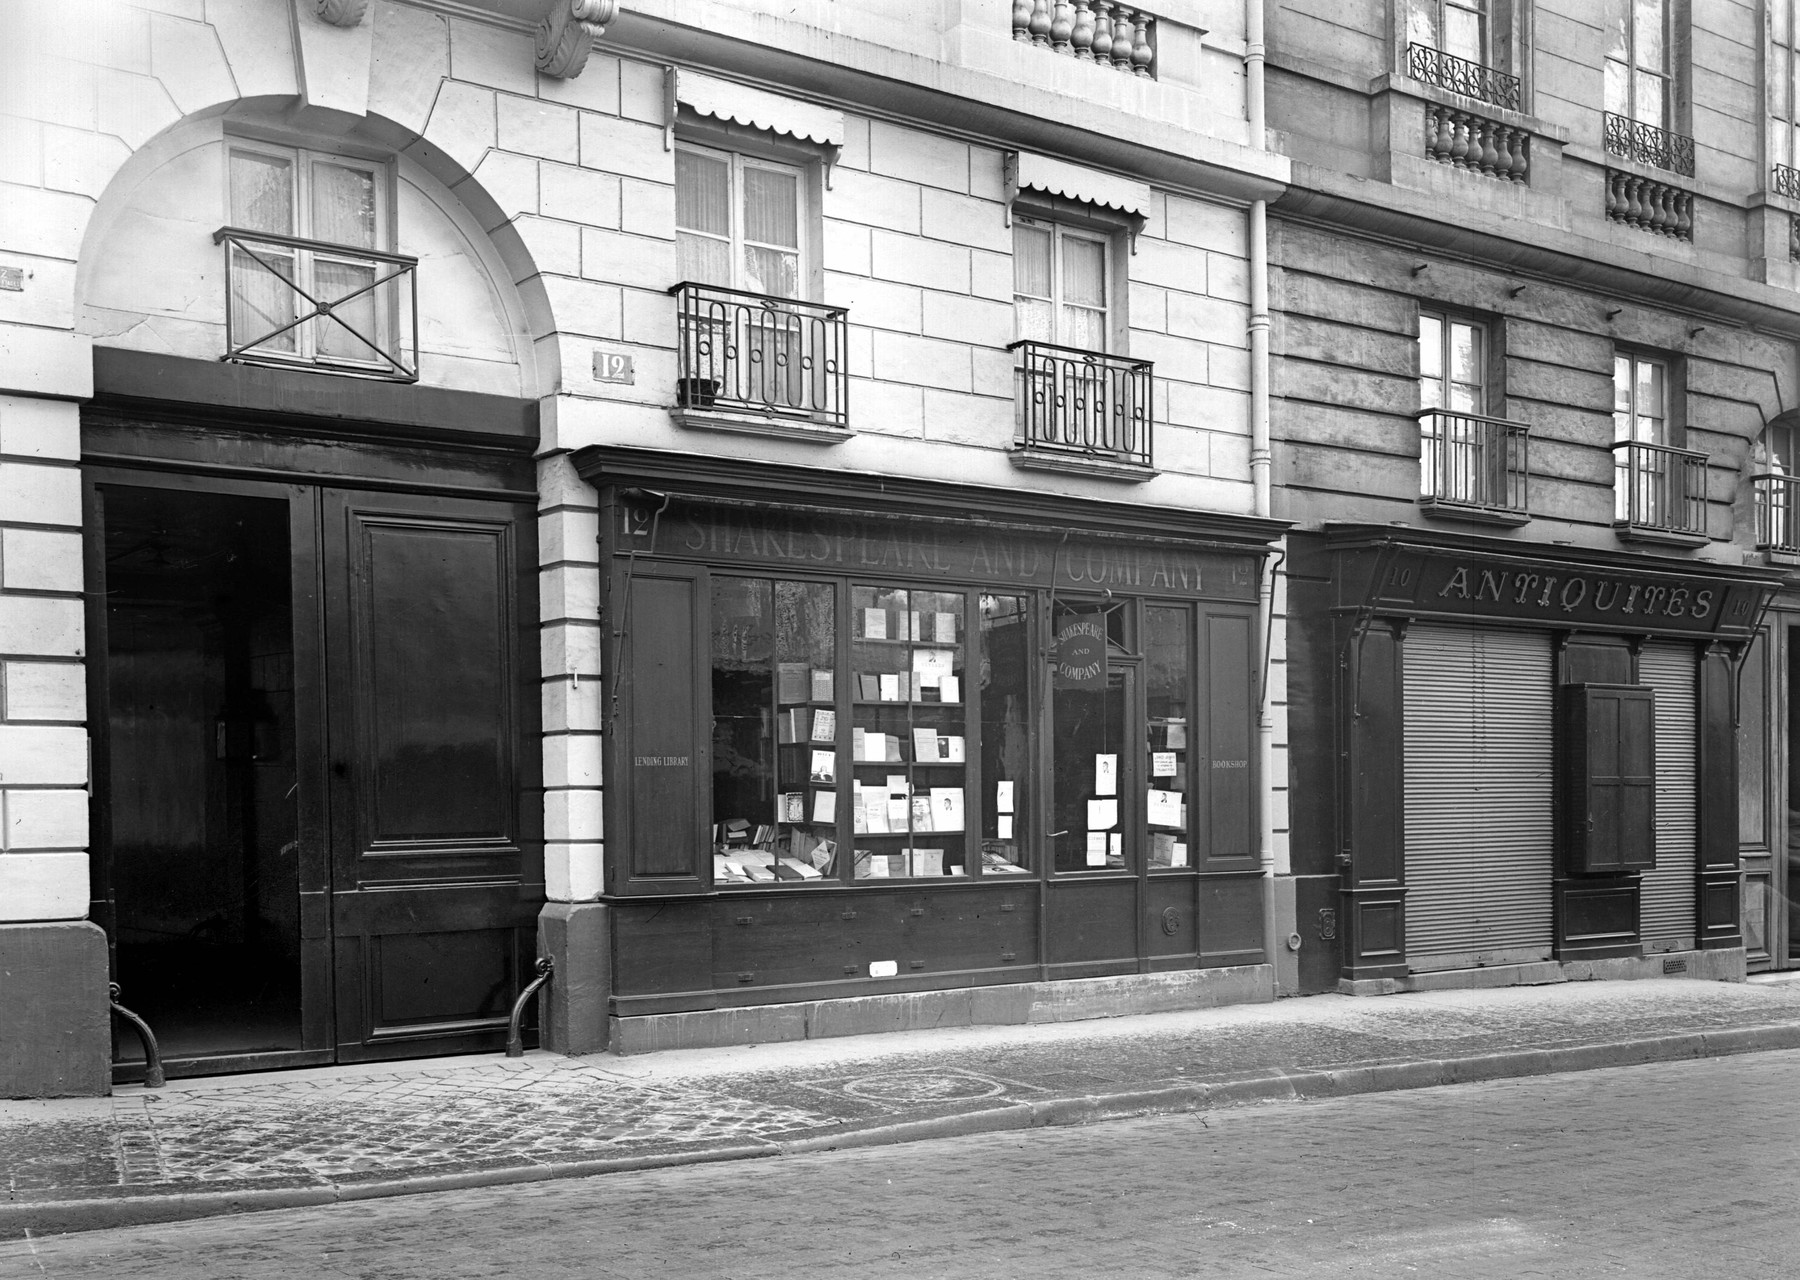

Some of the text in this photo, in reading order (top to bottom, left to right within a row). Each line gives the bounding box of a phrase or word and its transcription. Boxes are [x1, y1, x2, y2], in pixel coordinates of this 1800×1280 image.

[602, 354, 624, 379] 12
[622, 506, 649, 536] 12
[685, 510, 1204, 592] SHAKESPEARE AND COMPANY
[1389, 566, 1412, 588] 10
[1733, 599, 1751, 616] 10
[1057, 621, 1104, 646] SHAKESPEARE
[1072, 647, 1091, 656] AND
[1059, 658, 1102, 681] COMPANY
[634, 756, 689, 767] LENDING LIBRARY
[1212, 760, 1248, 769] BOOKSHOP
